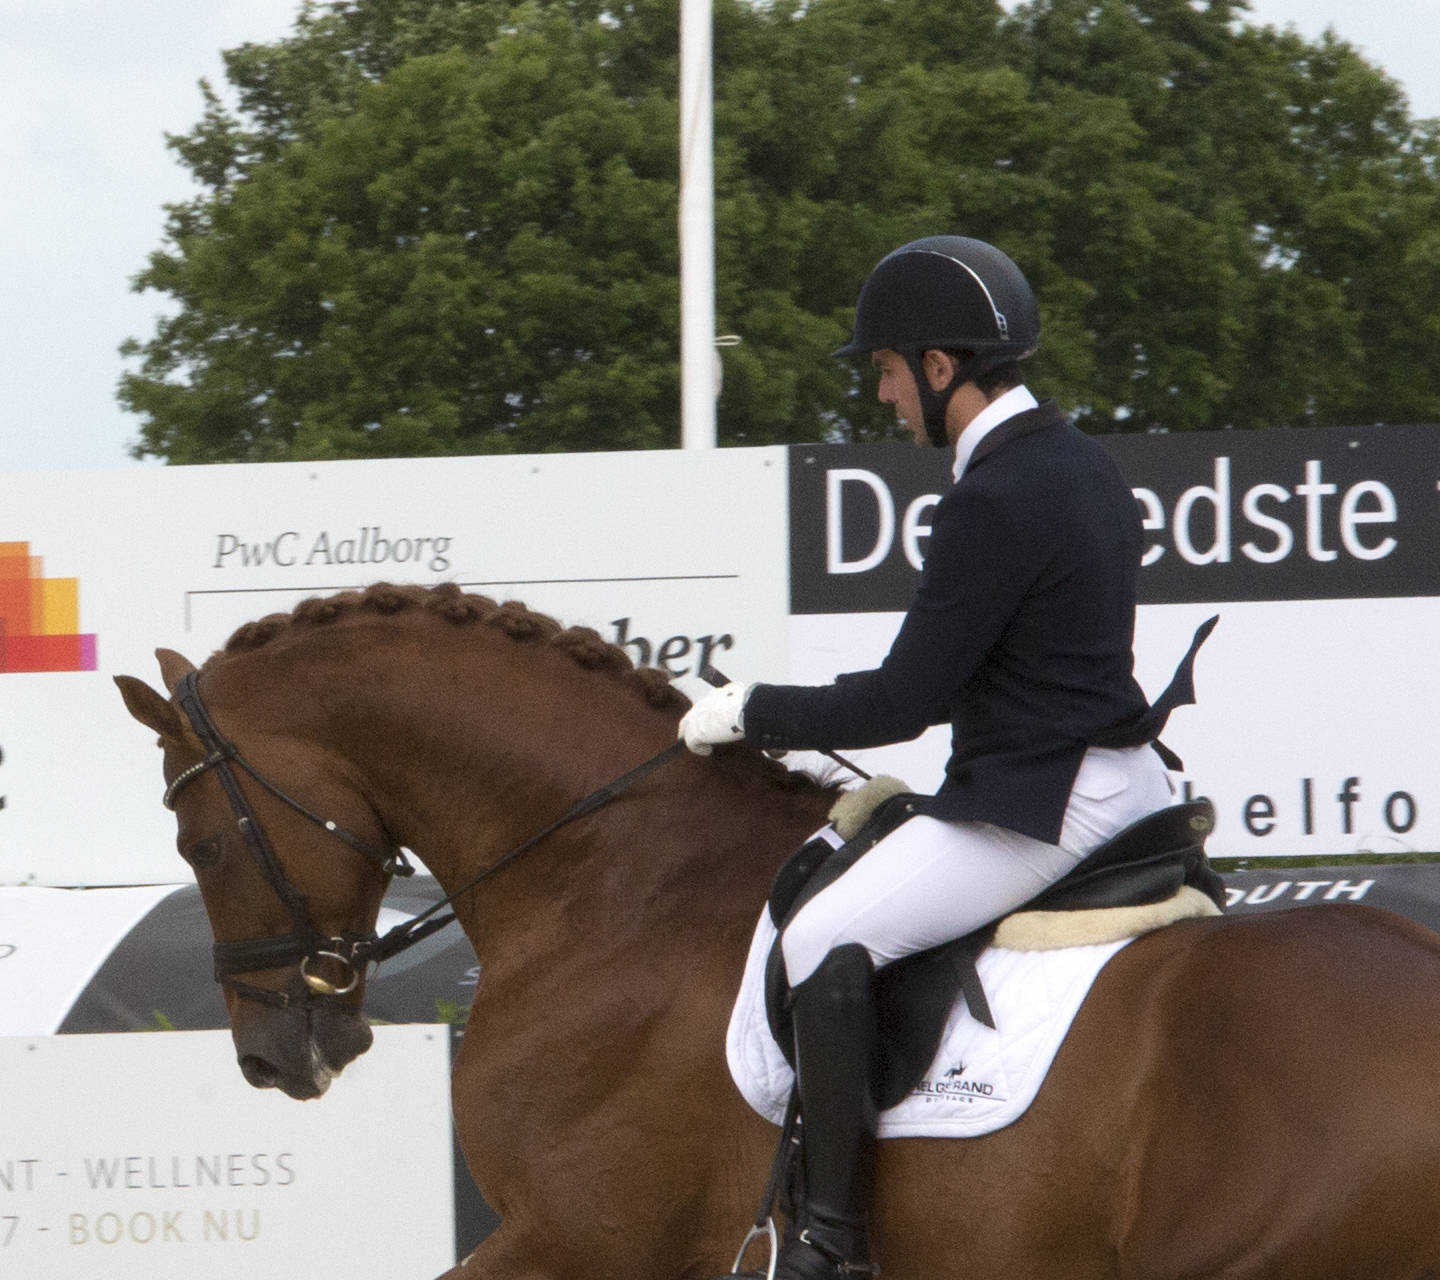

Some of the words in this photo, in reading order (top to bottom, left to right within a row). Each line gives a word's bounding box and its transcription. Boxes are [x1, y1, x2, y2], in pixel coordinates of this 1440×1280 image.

[212, 531, 300, 569] PwC
[304, 526, 454, 572] Aalborg
[83, 1152, 299, 1191] WELLNESS
[67, 1210, 186, 1248] BOOK
[203, 1207, 263, 1244] NU
